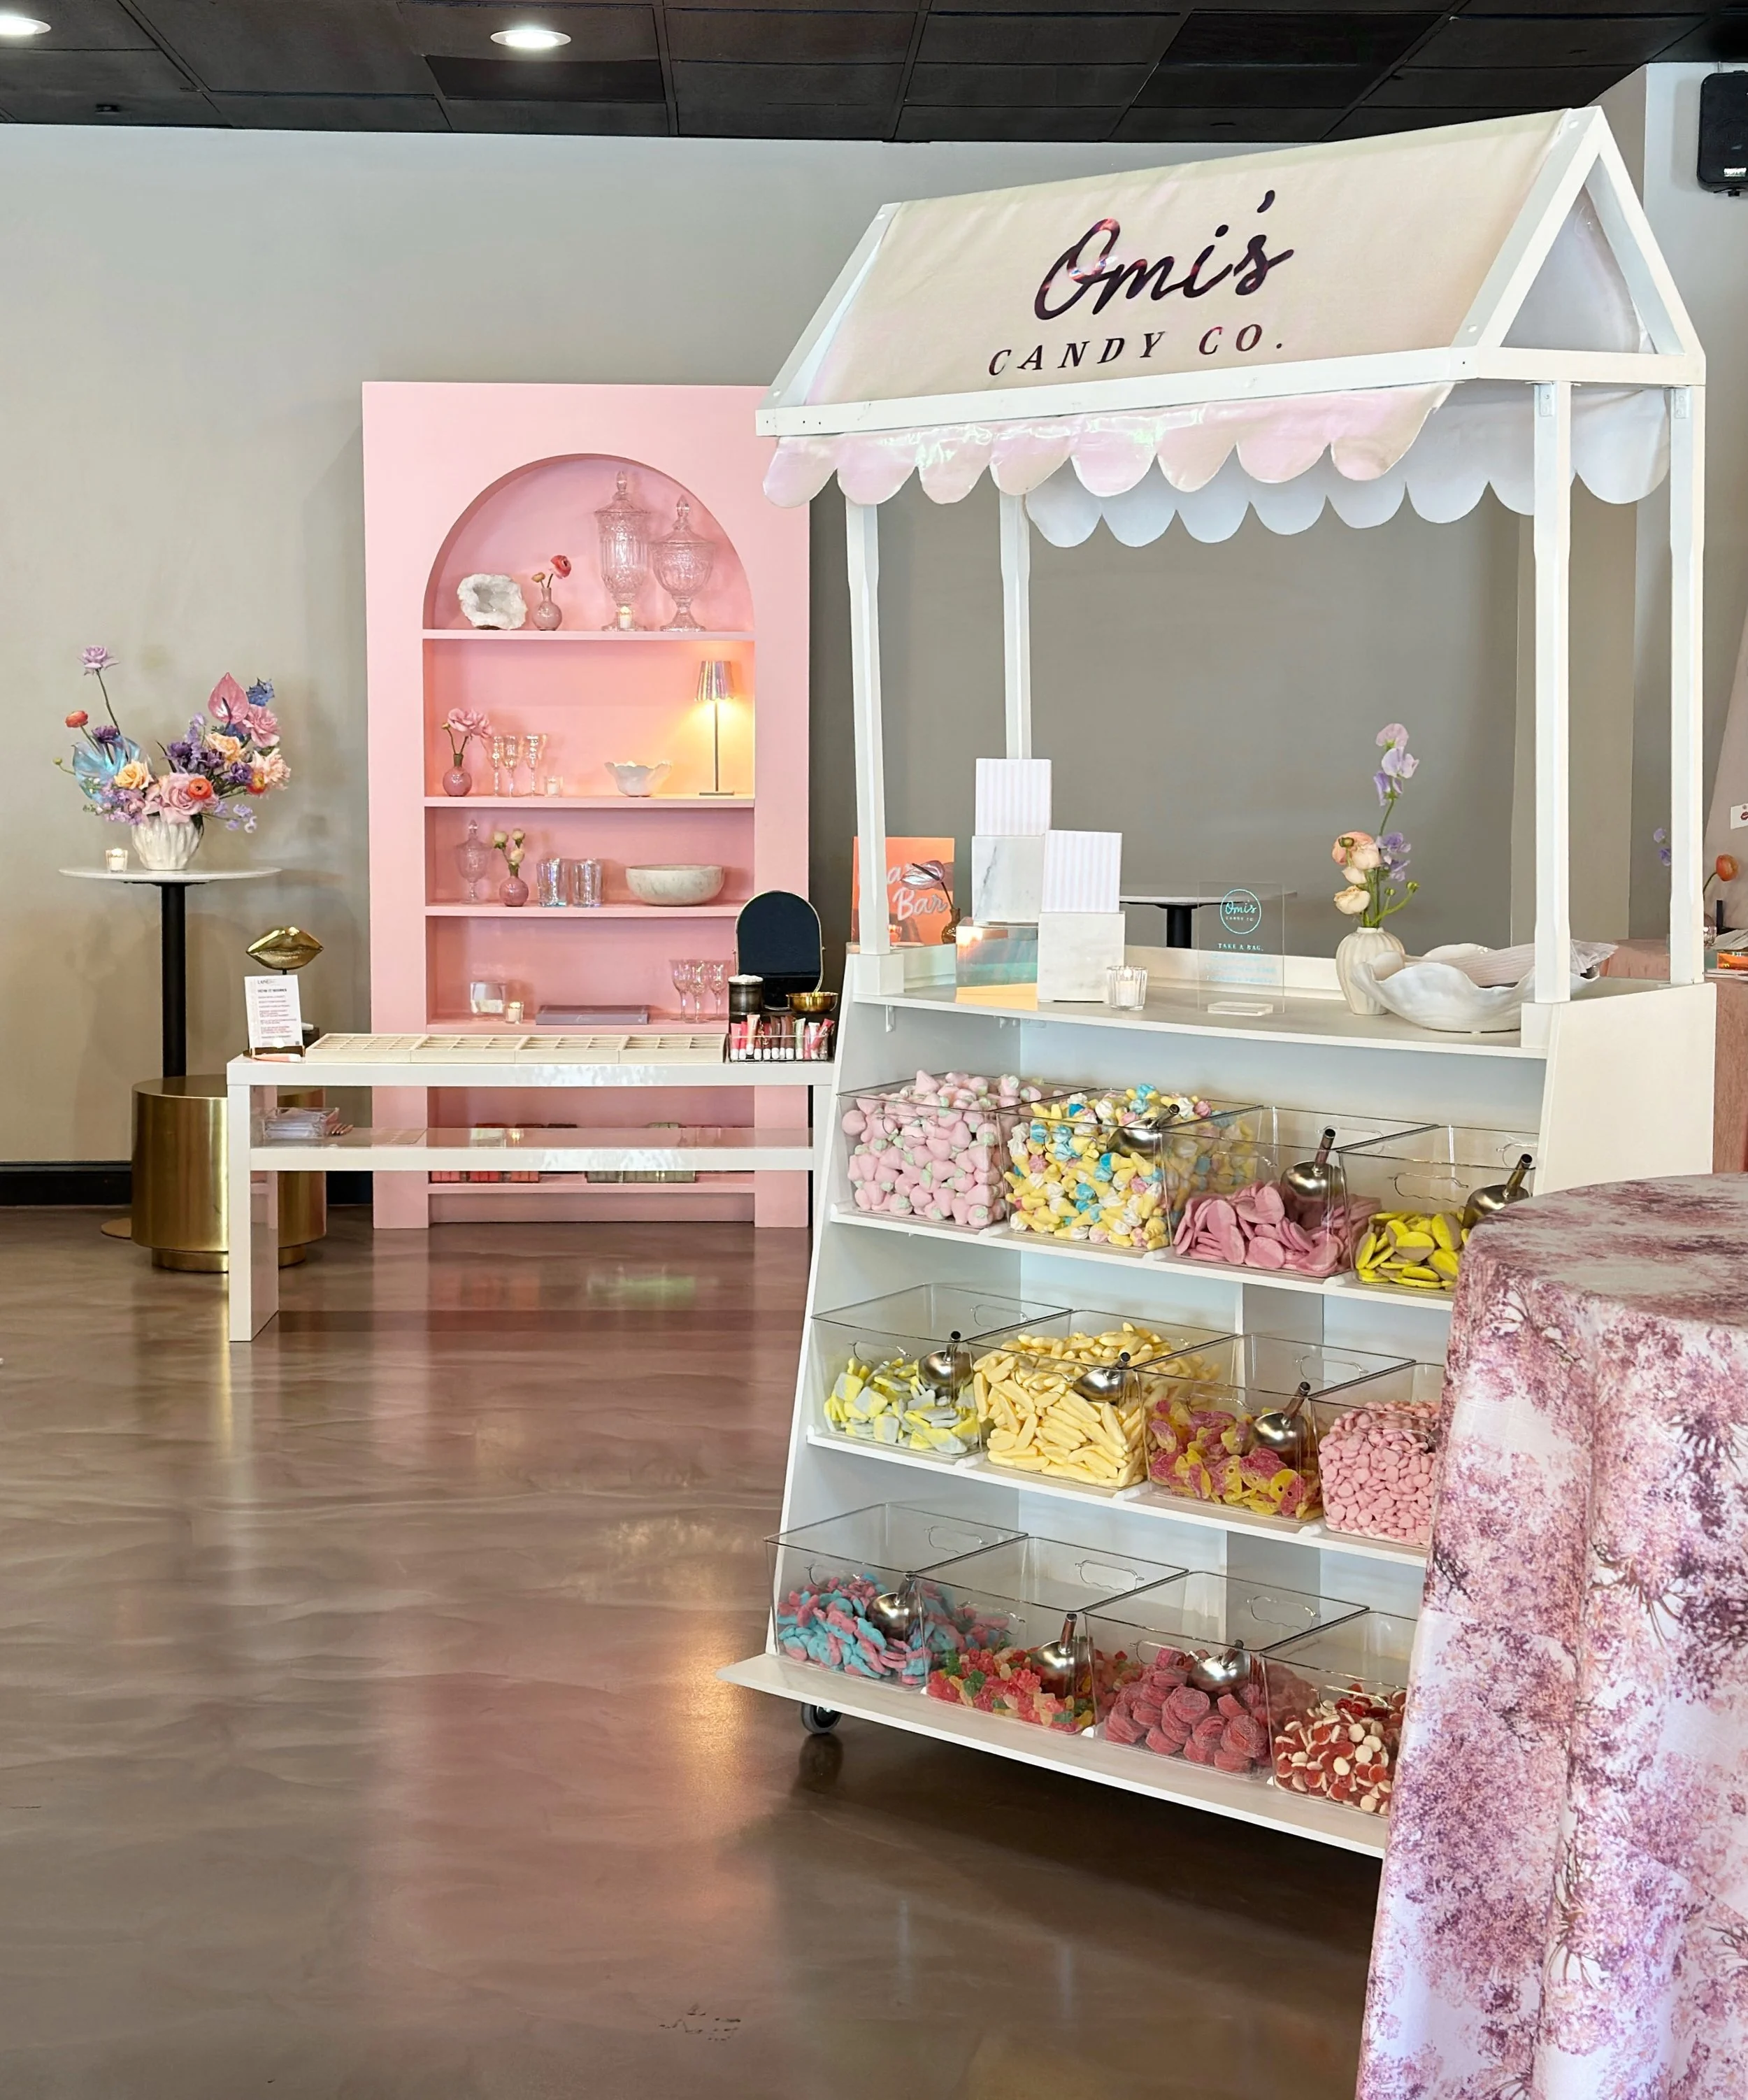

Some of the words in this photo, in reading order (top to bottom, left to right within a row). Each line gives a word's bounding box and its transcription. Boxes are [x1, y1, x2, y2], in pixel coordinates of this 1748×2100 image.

[1033, 189, 1295, 321] Omi's
[987, 330, 1168, 376] CANDY
[1198, 323, 1282, 356] CO.
[891, 886, 948, 922] Bar
[1225, 899, 1257, 915] Omi's
